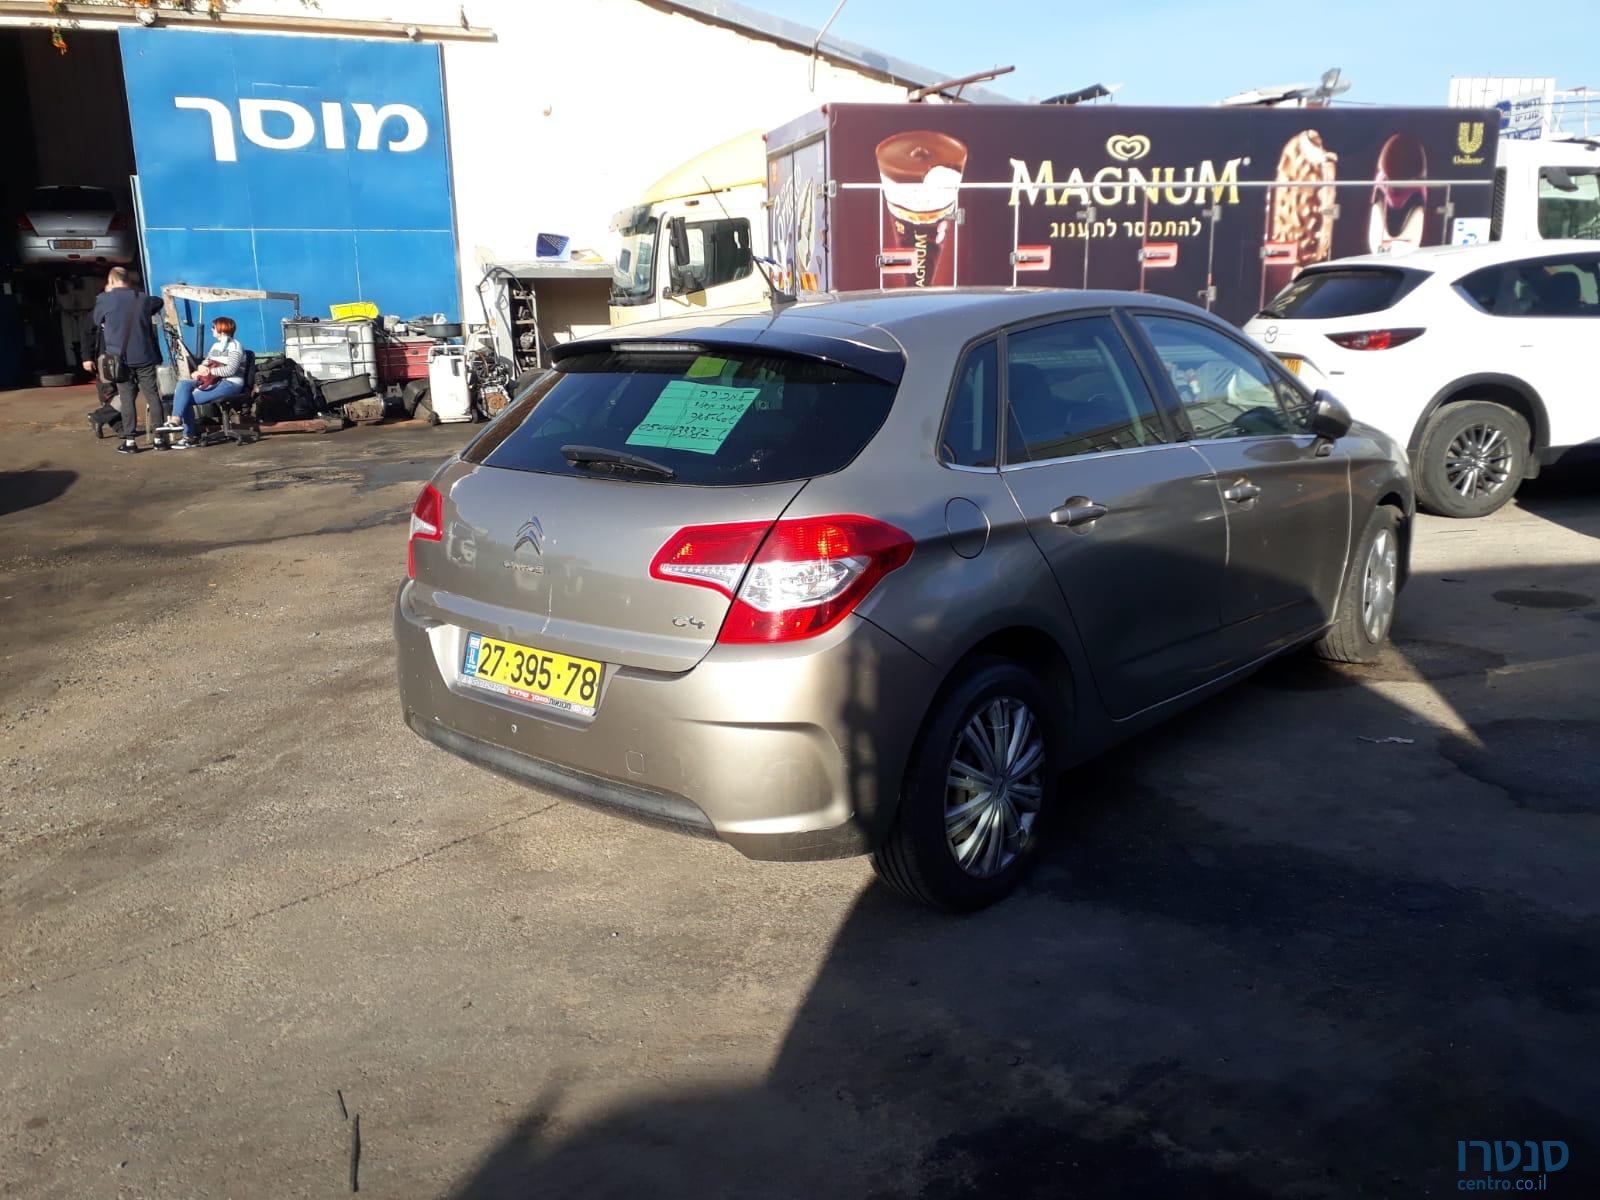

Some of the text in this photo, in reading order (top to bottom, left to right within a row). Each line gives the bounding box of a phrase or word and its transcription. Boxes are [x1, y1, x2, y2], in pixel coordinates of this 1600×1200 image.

[174, 96, 428, 162] מוסך
[1008, 157, 1243, 207] MAGNUM
[1049, 216, 1202, 239] להתמסר לתענוג
[914, 232, 929, 287] AGNUM
[672, 615, 706, 630] C4
